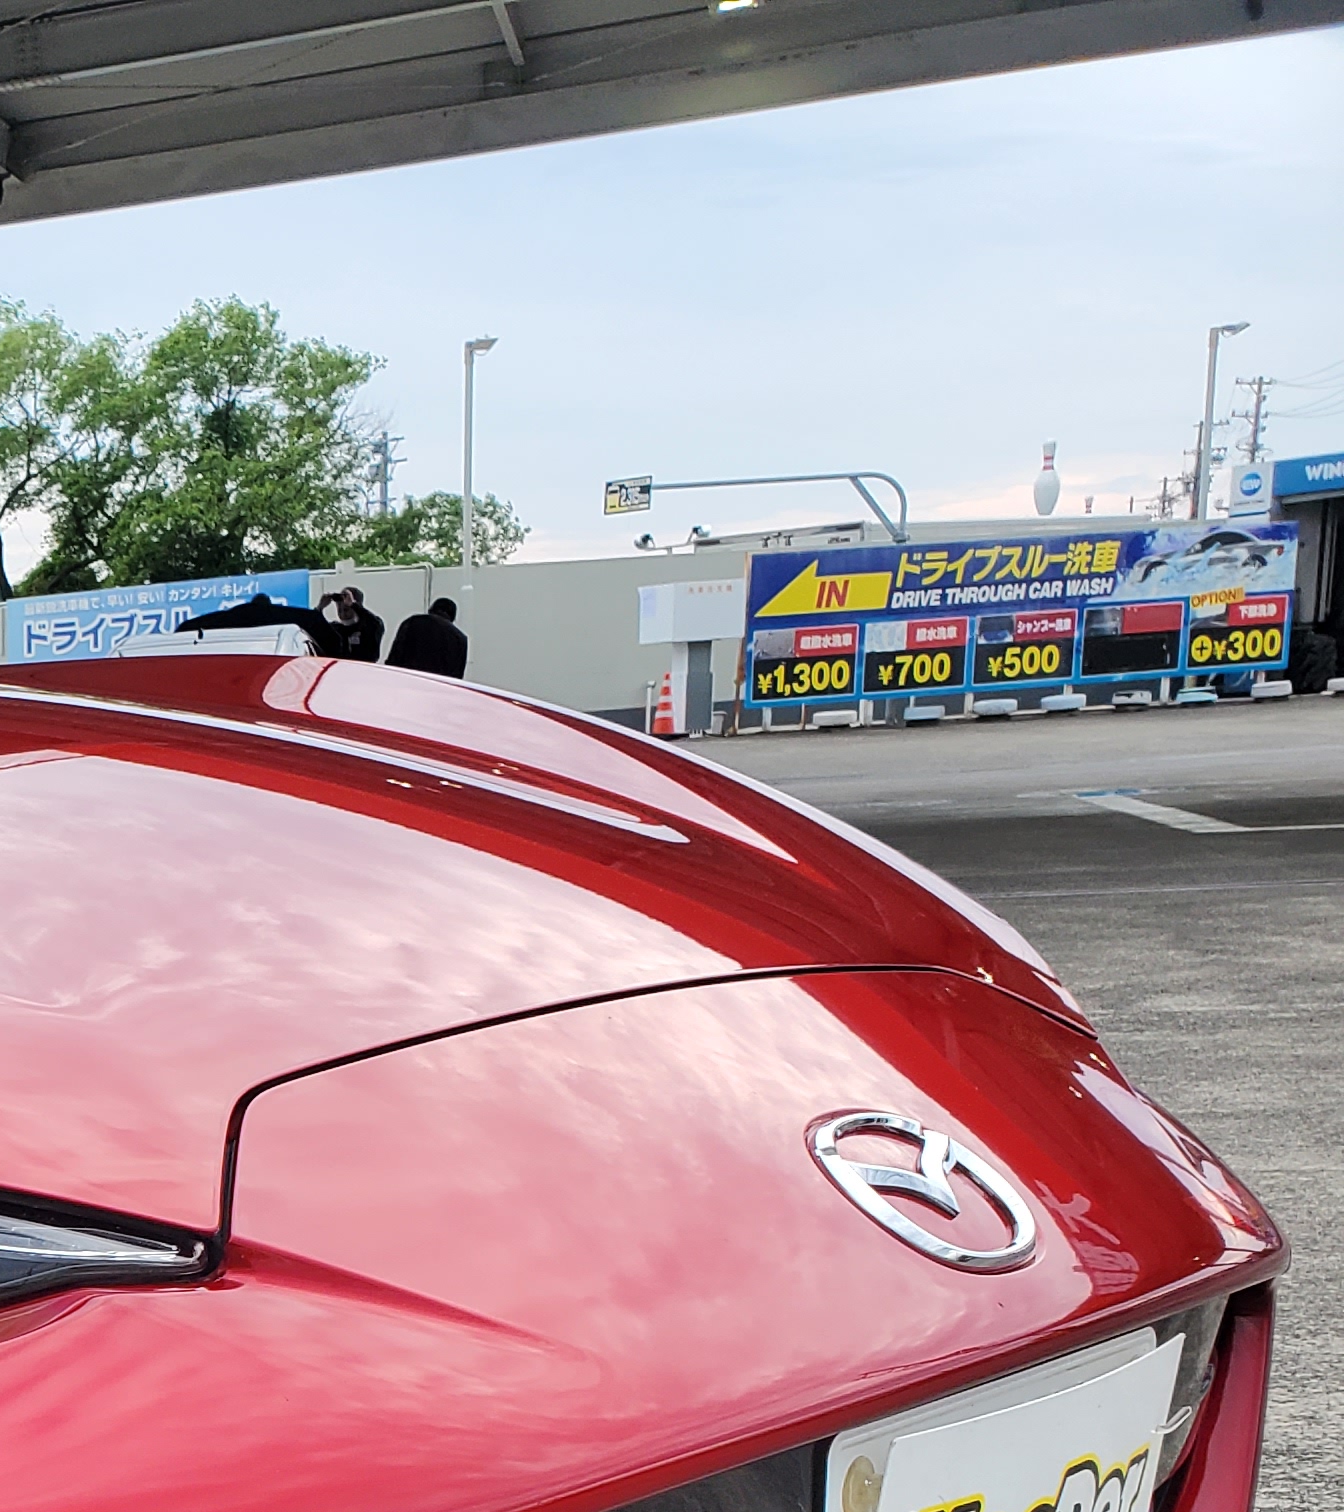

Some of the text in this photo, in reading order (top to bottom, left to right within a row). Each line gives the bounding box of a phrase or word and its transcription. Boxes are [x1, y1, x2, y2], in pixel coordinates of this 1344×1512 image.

[1305, 460, 1344, 481] WIN
[895, 540, 1121, 588] ドライブスルー洗車
[815, 578, 850, 609] IN
[891, 577, 1115, 609] DRIVE THROUGH CAR WASH
[757, 659, 850, 697] ¥1,300
[878, 652, 951, 687] ¥700
[988, 644, 1060, 678] ¥500
